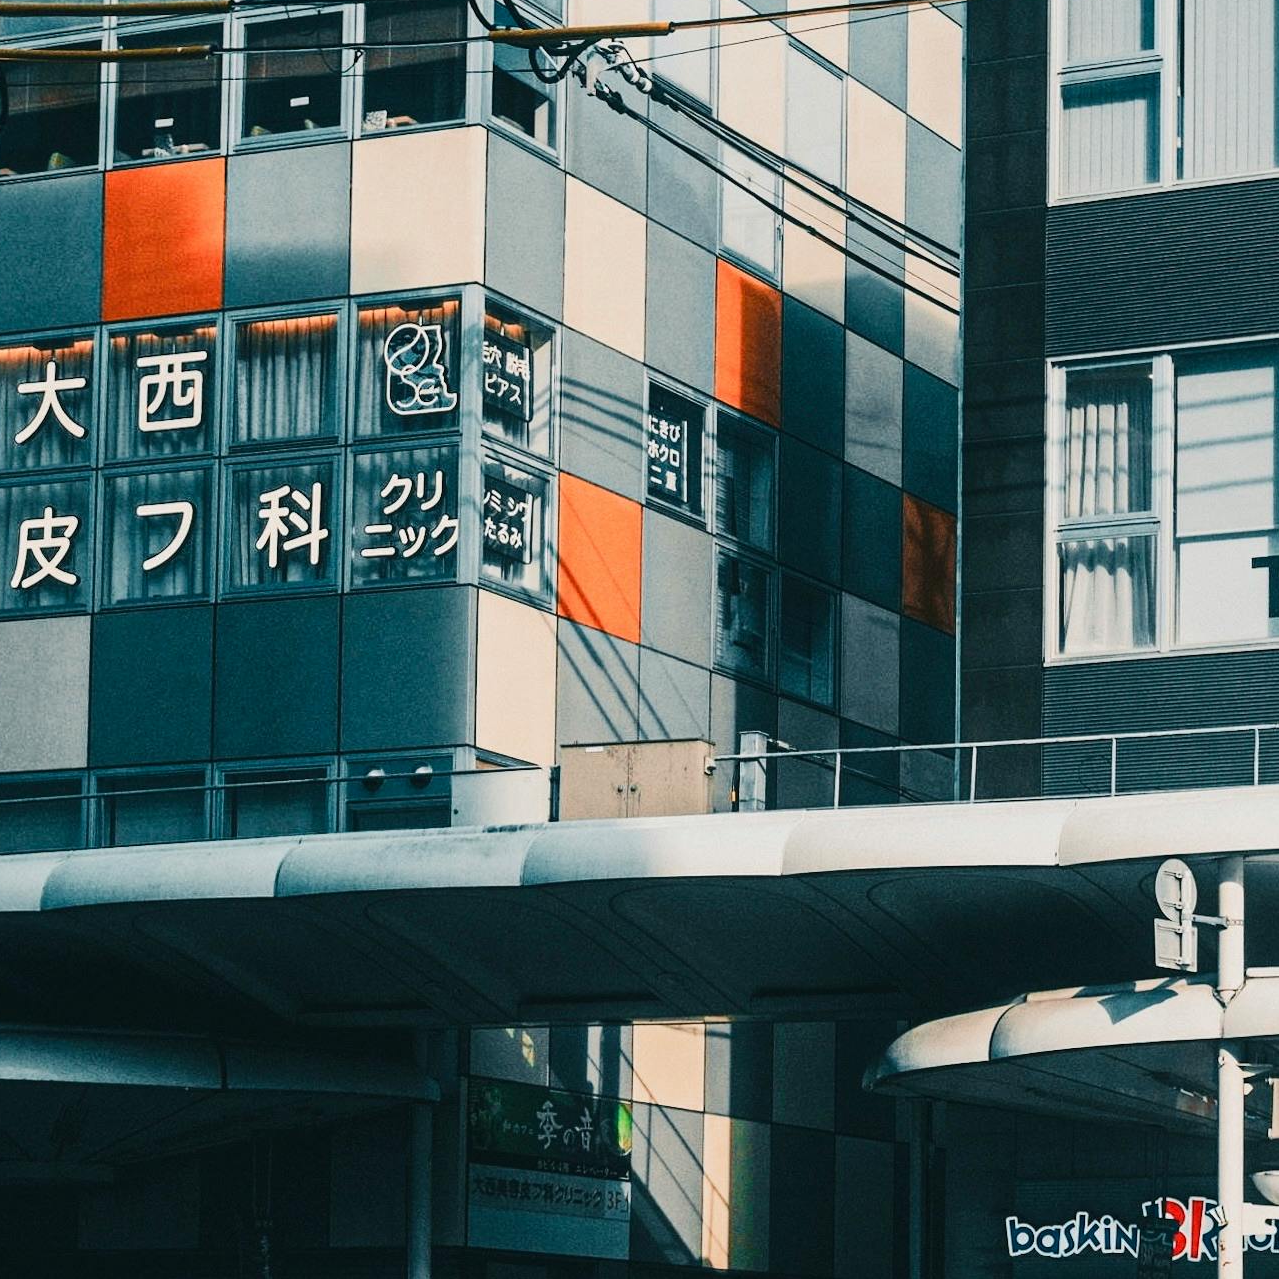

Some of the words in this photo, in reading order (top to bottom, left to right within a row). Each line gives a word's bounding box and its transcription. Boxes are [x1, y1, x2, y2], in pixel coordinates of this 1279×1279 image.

[13, 349, 209, 444] 大西
[485, 372, 521, 405] ピアス
[648, 414, 681, 443] にきび
[647, 439, 680, 468] ホクロ
[484, 517, 523, 549] たるみ
[1006, 1212, 1140, 1259] baskin
